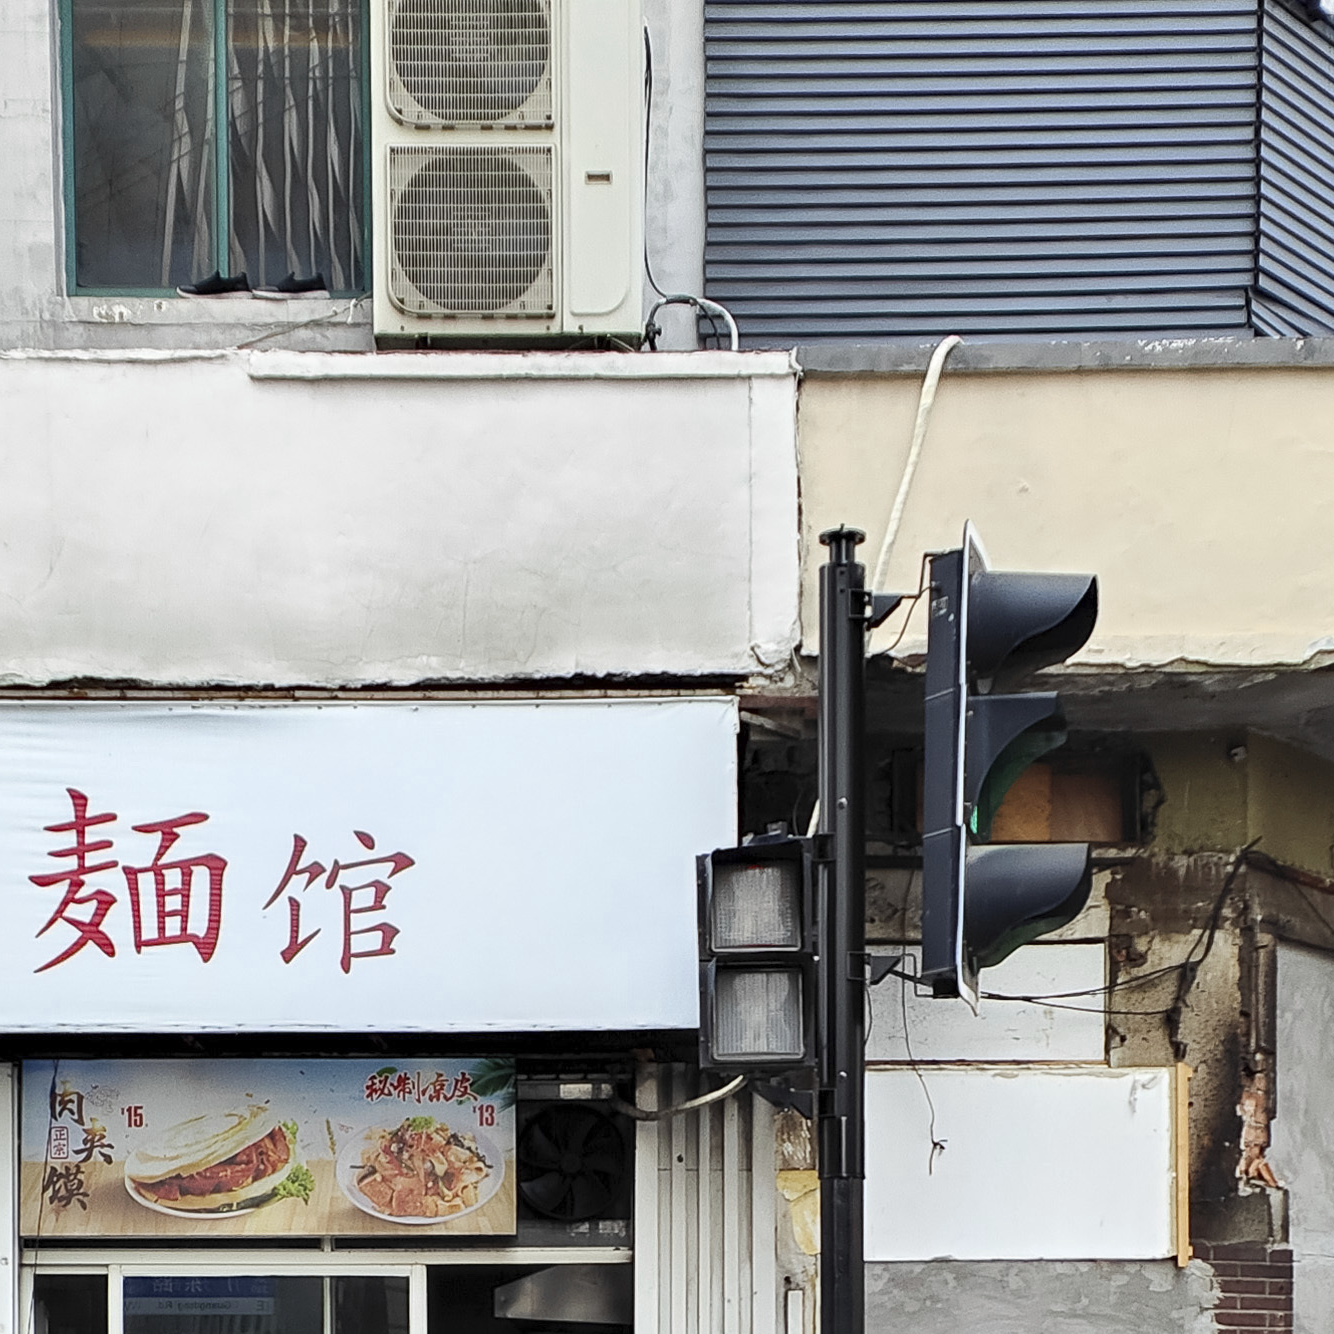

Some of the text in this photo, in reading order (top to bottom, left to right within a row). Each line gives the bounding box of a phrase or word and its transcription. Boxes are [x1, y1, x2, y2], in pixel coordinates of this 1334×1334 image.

[365, 1071, 479, 1104] 秘制凉皮
[43, 1079, 115, 1211] 肉夹馍
